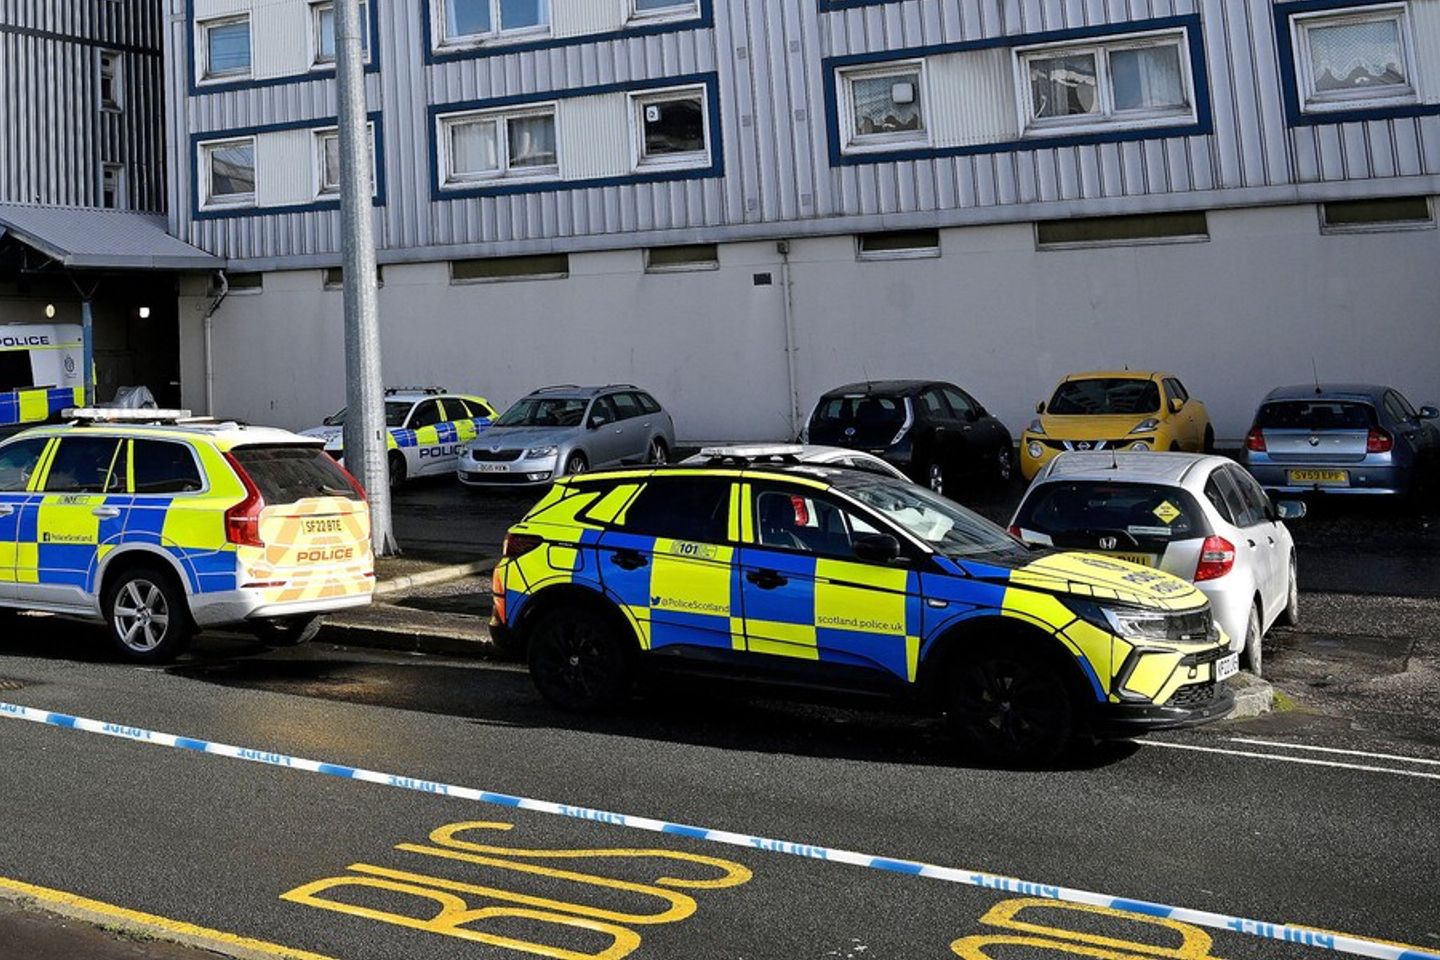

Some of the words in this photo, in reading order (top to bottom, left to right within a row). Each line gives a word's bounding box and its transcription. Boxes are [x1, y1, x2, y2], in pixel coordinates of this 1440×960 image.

[296, 548, 353, 562] POLICE
[679, 543, 698, 555] 101
[661, 598, 729, 613] @PoliceScotland
[817, 615, 904, 632] scotland.police.uk
[278, 820, 754, 960] BUS
